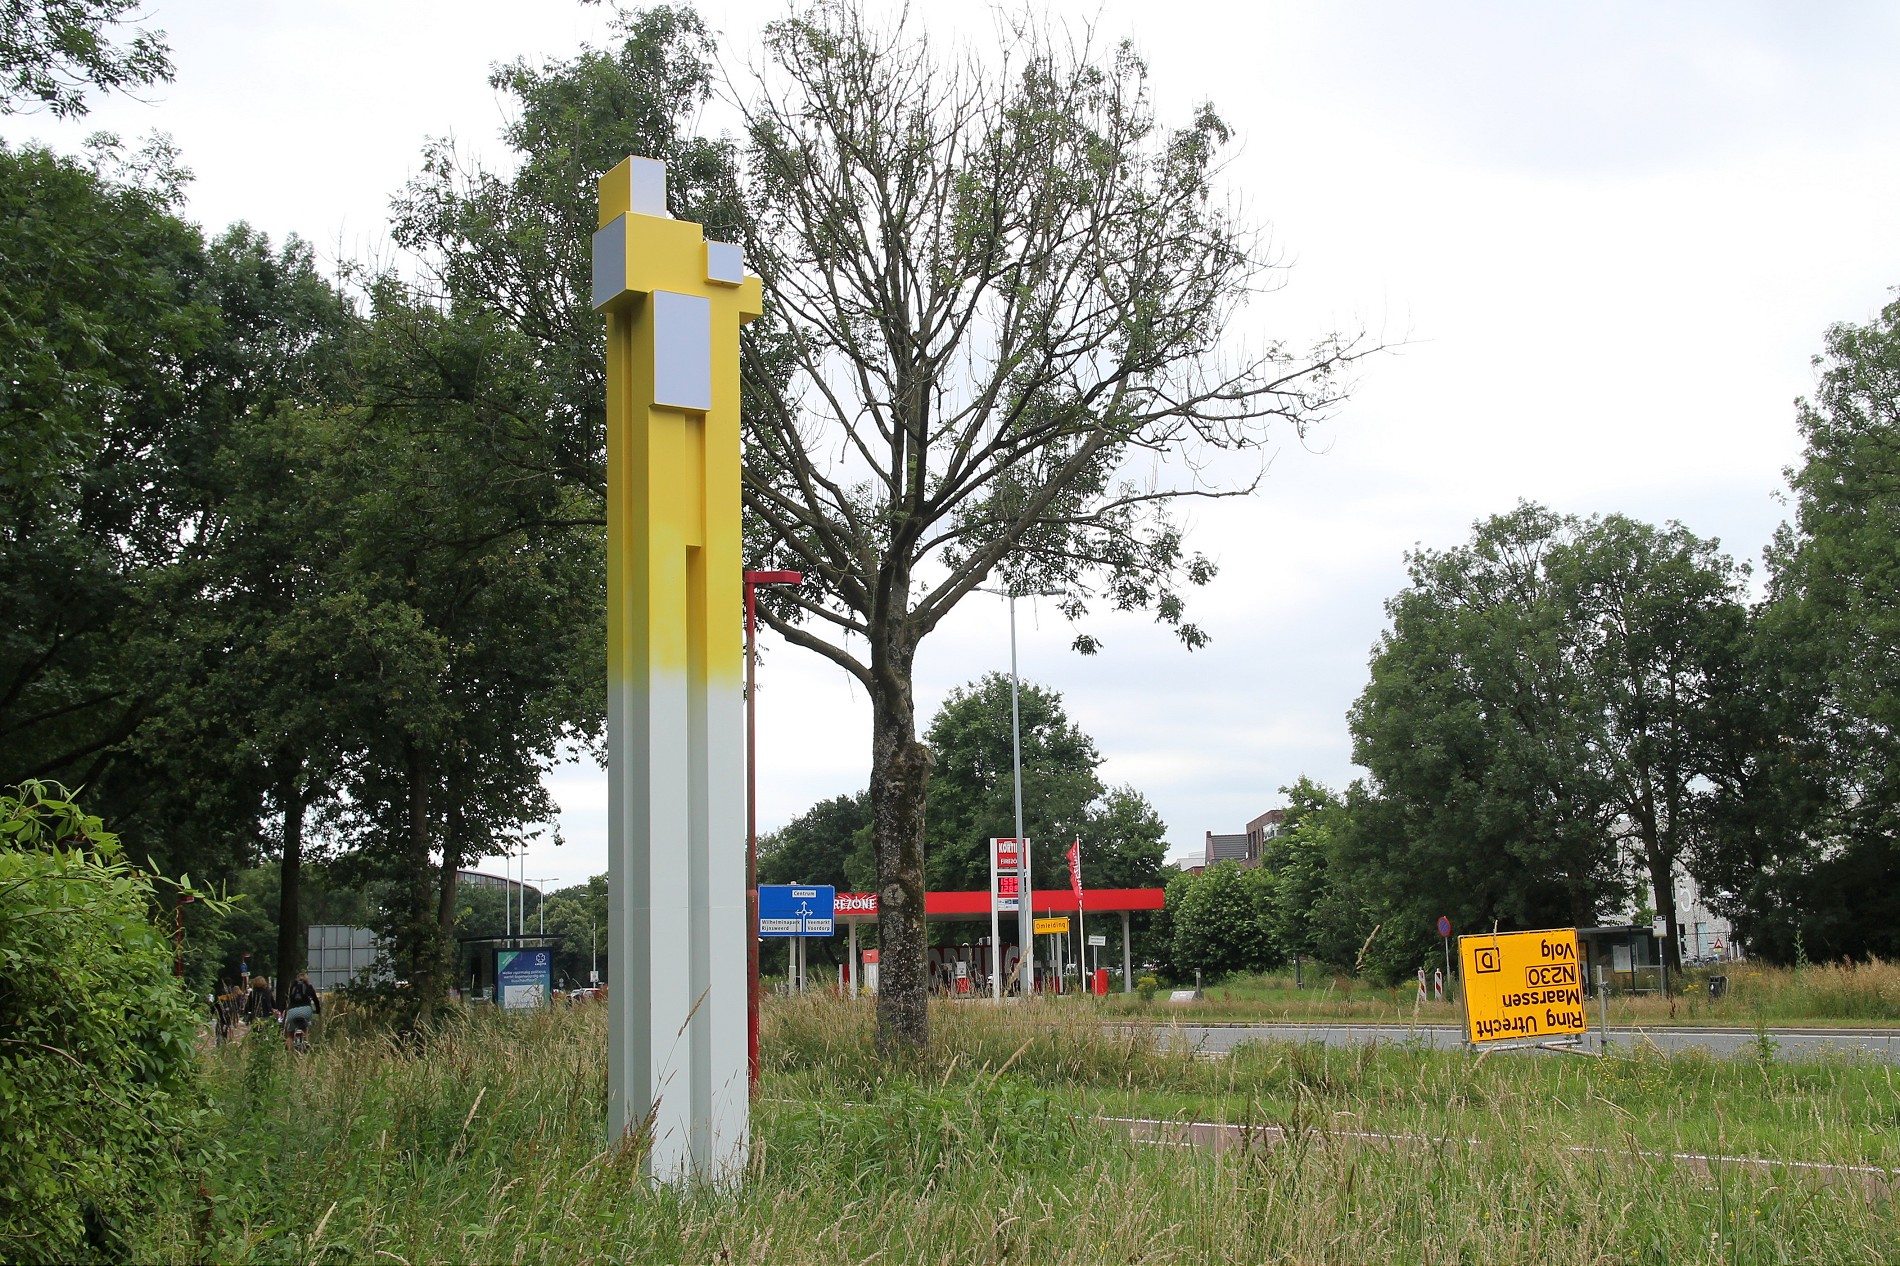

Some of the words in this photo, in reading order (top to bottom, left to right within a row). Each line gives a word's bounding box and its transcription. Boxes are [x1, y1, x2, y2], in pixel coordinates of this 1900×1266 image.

[833, 898, 876, 910] REZONE
[1541, 939, 1575, 960] Volg
[1481, 952, 1493, 969] D
[1528, 965, 1575, 985] N230
[1502, 988, 1580, 1007] Maarssen
[1476, 1015, 1537, 1037] Utrecht
[1546, 1008, 1583, 1028] Ring
